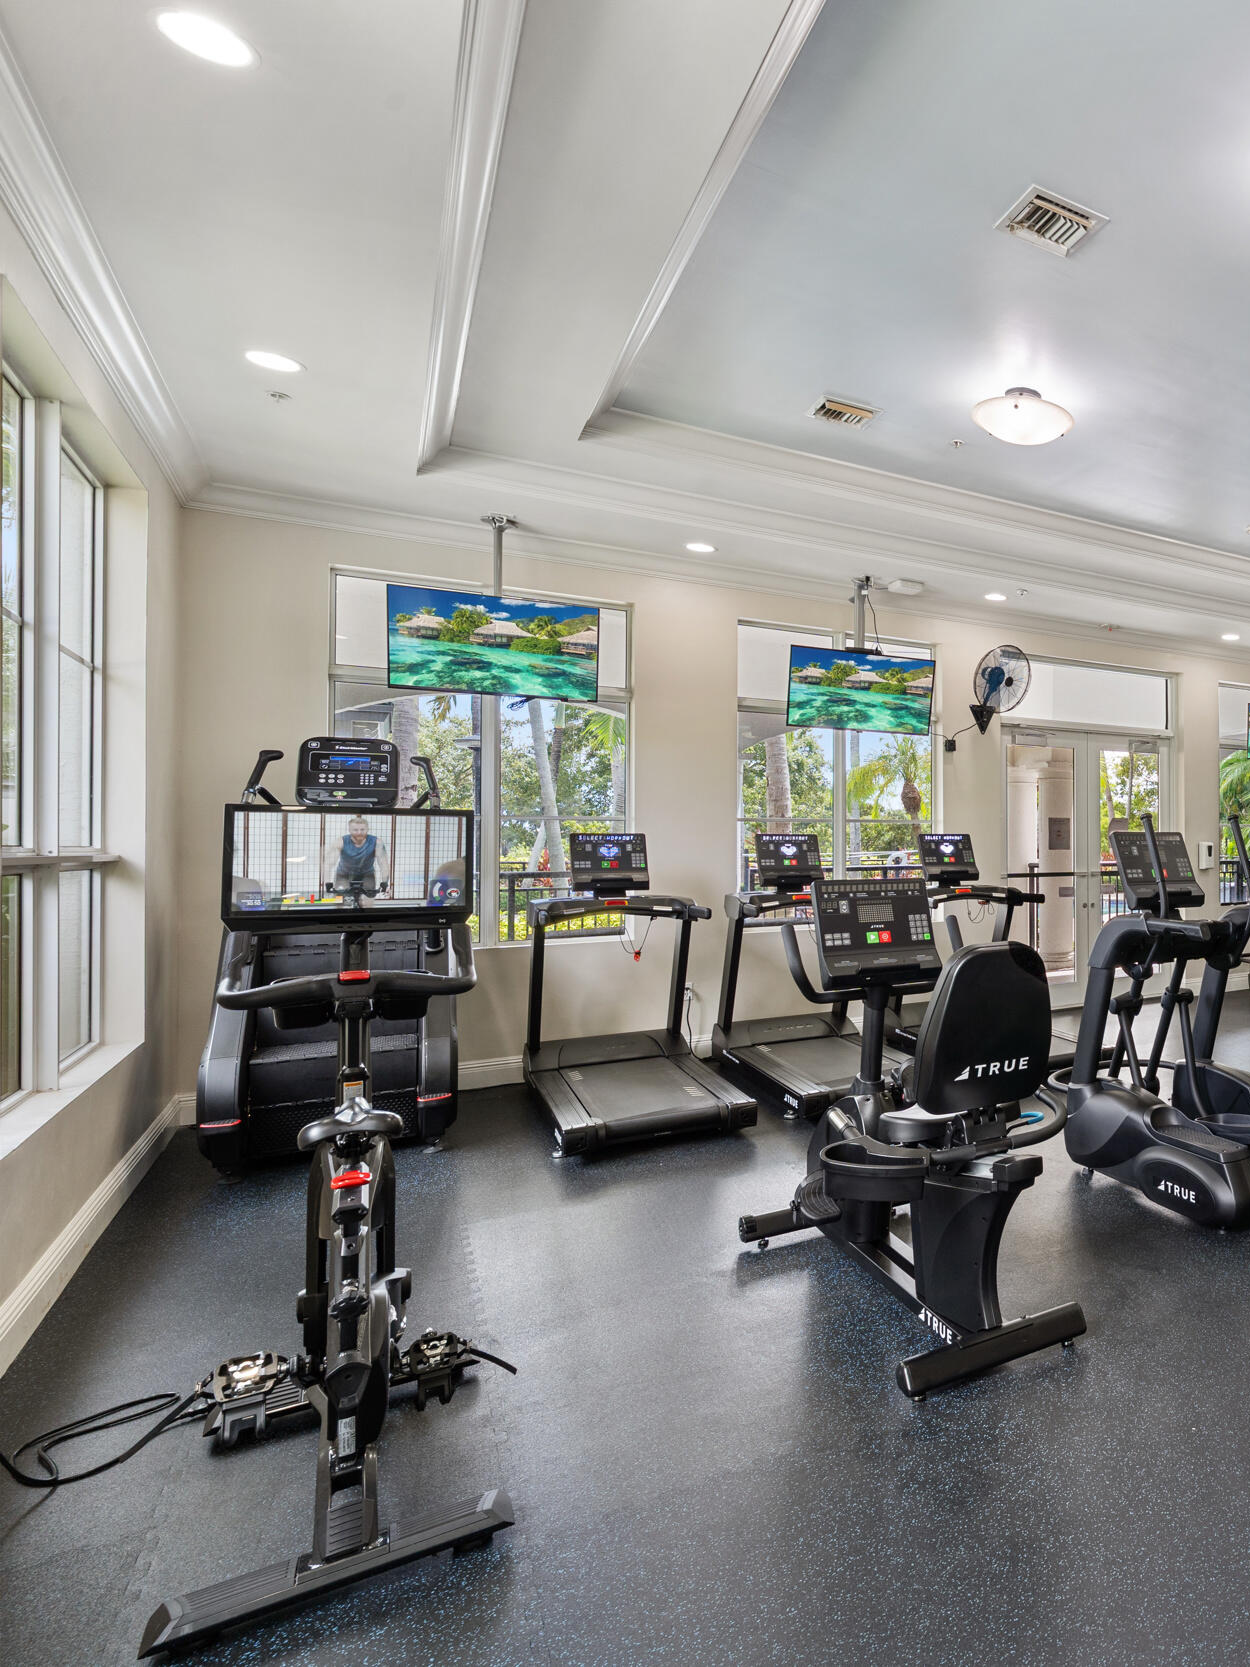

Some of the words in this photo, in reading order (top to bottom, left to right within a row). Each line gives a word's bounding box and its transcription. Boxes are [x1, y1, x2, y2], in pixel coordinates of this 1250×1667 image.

[975, 1057, 1029, 1078] TRUE
[1166, 1181, 1196, 1204] TRUE
[926, 1310, 953, 1345] TRUE
